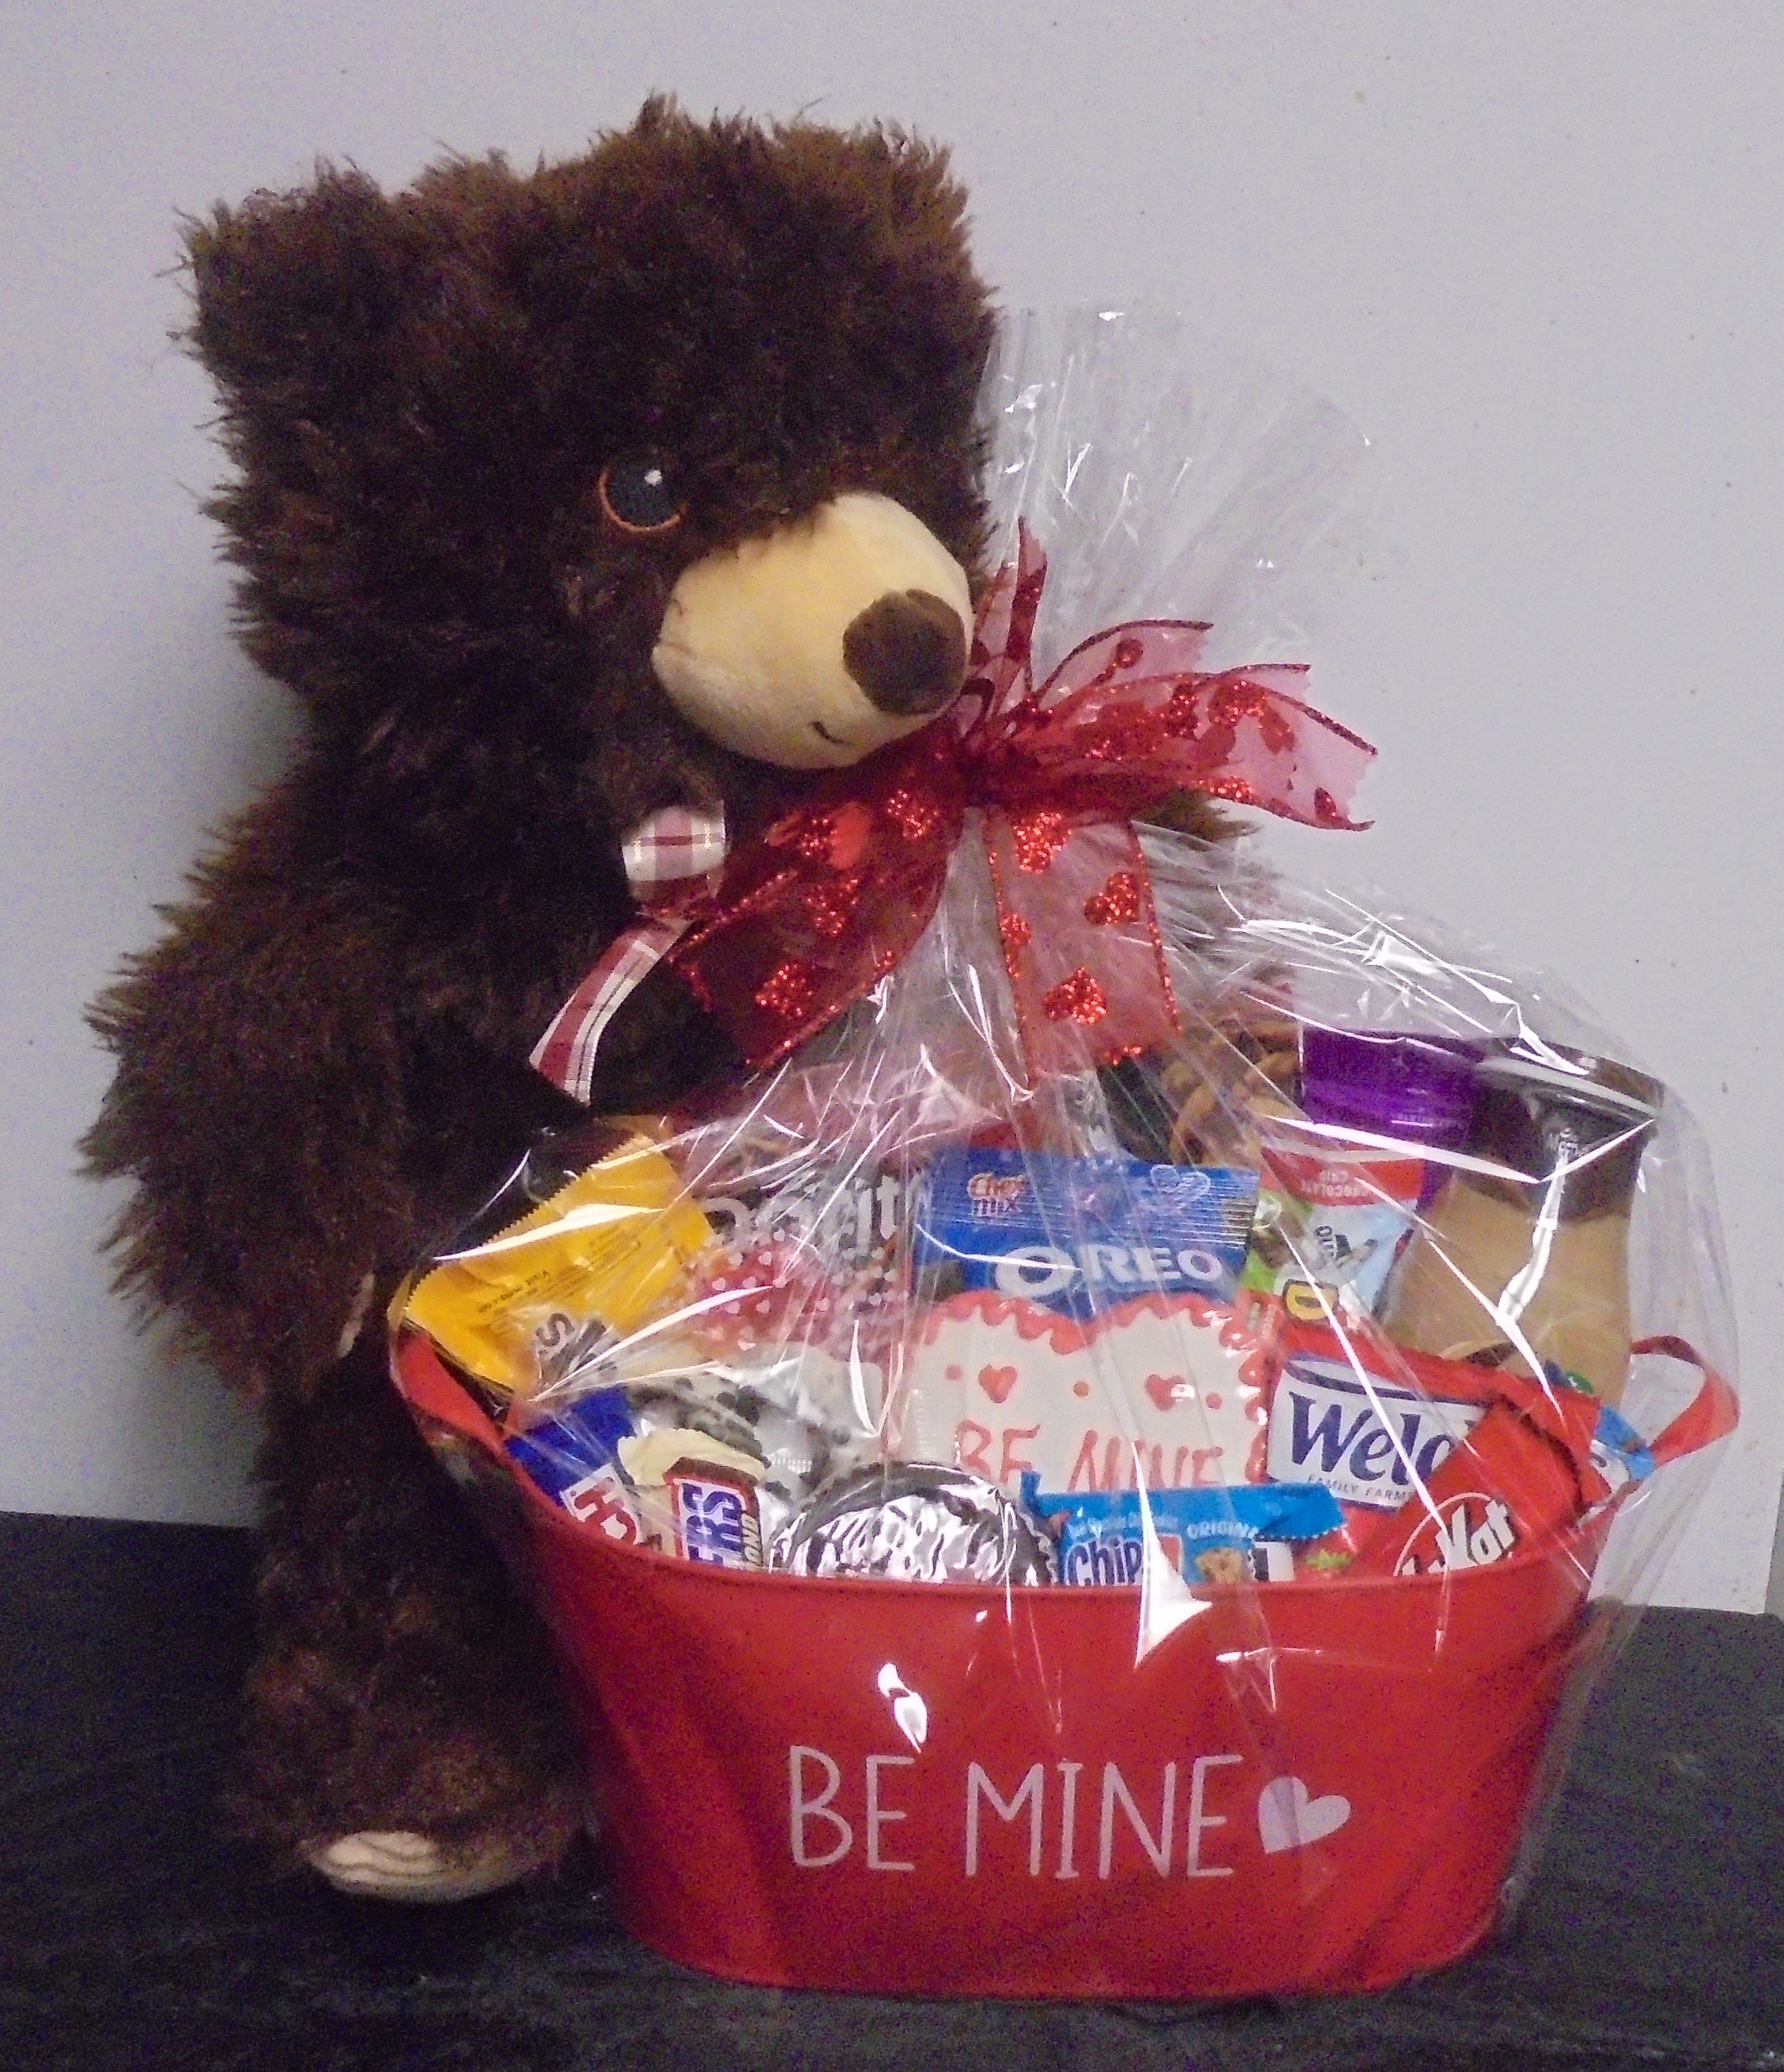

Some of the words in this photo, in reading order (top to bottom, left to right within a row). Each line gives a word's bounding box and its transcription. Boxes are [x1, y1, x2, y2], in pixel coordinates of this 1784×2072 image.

[995, 1243, 1223, 1299] OREO
[954, 1419, 1041, 1484] BE
[1288, 1391, 1455, 1486] Welc
[1307, 1474, 1358, 1494] FAMILY
[1365, 1486, 1406, 1501] FARM
[1065, 1536, 1144, 1586] Chip
[788, 1743, 916, 1872] BE
[966, 1754, 1244, 1879] MINE
